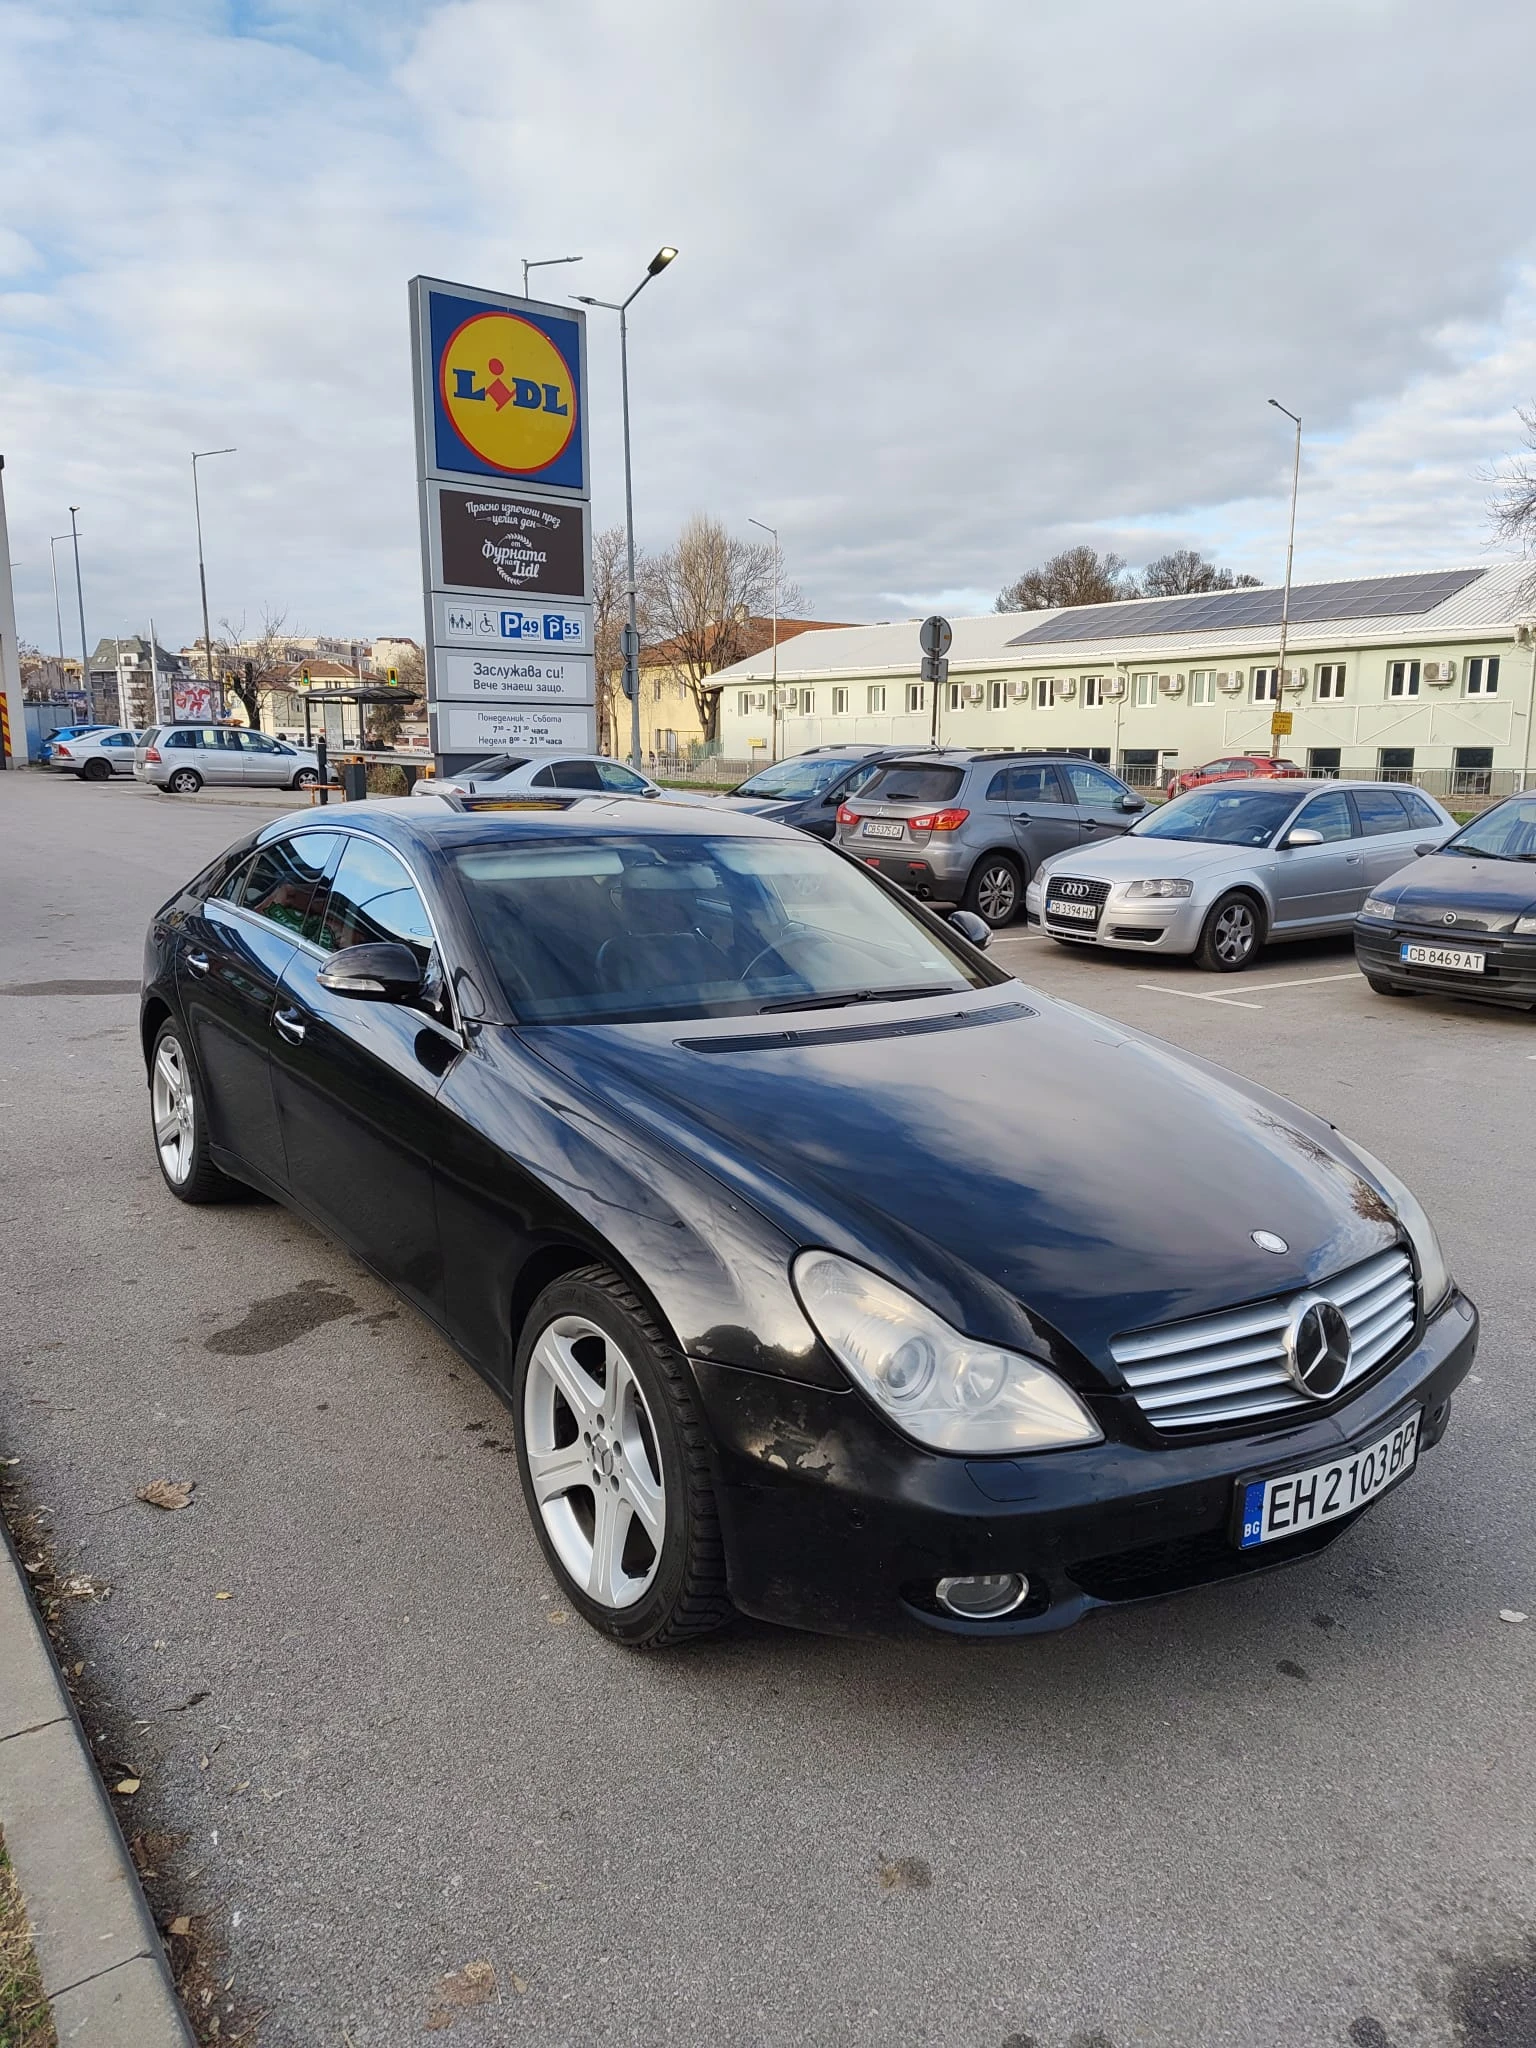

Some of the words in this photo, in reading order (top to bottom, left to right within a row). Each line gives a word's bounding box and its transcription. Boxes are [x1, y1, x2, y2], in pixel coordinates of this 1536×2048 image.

[466, 502, 500, 517] Прясно
[502, 504, 540, 518] изпечени
[541, 512, 560, 528] през
[492, 515, 518, 526] целия
[520, 518, 536, 530] ден
[482, 538, 547, 564] Фурната
[512, 560, 540, 578] Lidl
[522, 620, 538, 633] 49
[564, 623, 579, 634] 55
[473, 662, 542, 680] Заслужава
[546, 666, 564, 679] си!
[473, 679, 498, 690] Вече
[501, 682, 533, 692] знаеш
[536, 684, 564, 694] защо.
[478, 713, 524, 724] Понеделник
[532, 714, 562, 723] Събота
[478, 736, 506, 746] Неделя
[1244, 1521, 1260, 1538] BG
